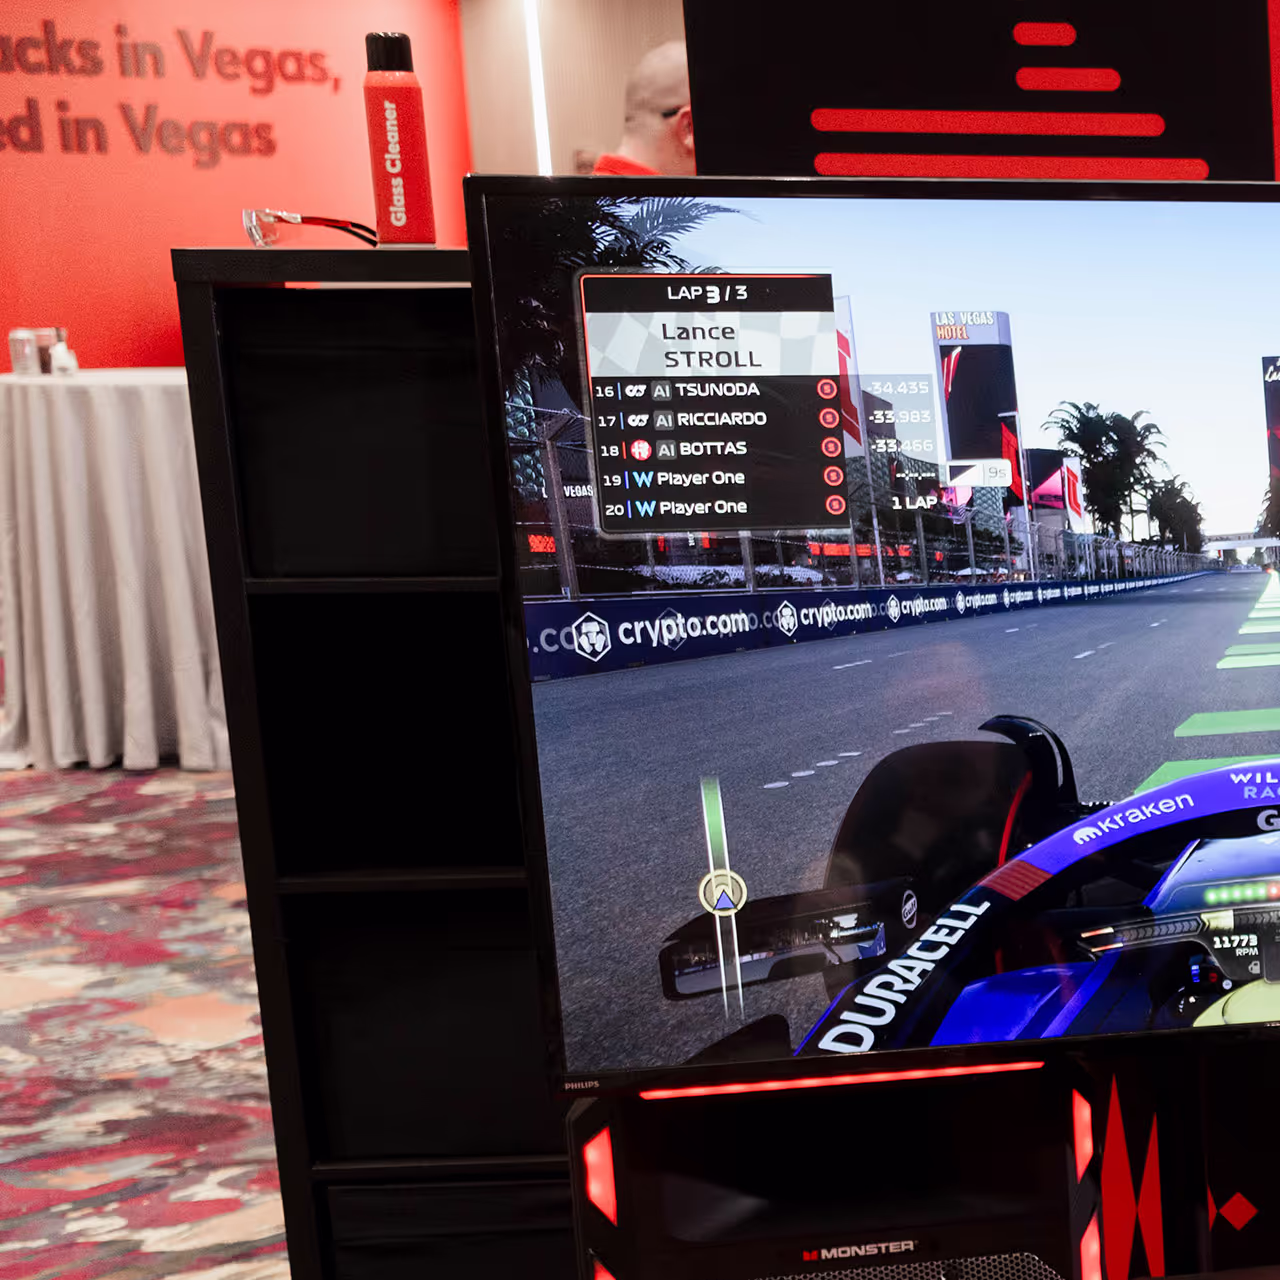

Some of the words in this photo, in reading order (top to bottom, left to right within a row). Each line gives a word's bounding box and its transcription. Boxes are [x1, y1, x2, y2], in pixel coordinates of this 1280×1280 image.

[113, 23, 165, 78] in
[176, 28, 341, 95] Vegas,
[57, 100, 108, 154] in
[120, 102, 277, 170] Vegas
[384, 99, 403, 175] Cleaner
[390, 177, 407, 228] Glass
[667, 286, 702, 300] LAP
[935, 312, 954, 325] LAS
[960, 312, 994, 325] VEGAS
[662, 323, 736, 341] Lance
[936, 325, 970, 339] HOTEL
[665, 350, 763, 369] STROLL
[596, 386, 615, 398] 16
[675, 382, 760, 397] TSUNODA
[866, 381, 929, 396] -34.435
[598, 416, 616, 427] 17
[677, 411, 767, 426] RICCIARDO
[868, 410, 932, 424] -33.983
[600, 445, 619, 457] 18
[680, 441, 748, 456] BOTTAS
[871, 439, 934, 453] -33.466
[603, 475, 621, 487] 19
[657, 472, 710, 488] Player
[716, 471, 746, 485] One
[564, 485, 594, 497] VEGAS
[605, 504, 625, 516] 20
[660, 501, 713, 517] Player
[718, 500, 748, 514] One
[892, 497, 901, 510] 1
[906, 496, 938, 510] LAP
[800, 600, 874, 628] crypto.com
[901, 596, 947, 617] crypto.com
[617, 612, 750, 648] crypto.com
[1098, 793, 1195, 833] kraken
[1213, 934, 1258, 949] 11773
[1236, 948, 1259, 957] RPM
[818, 900, 991, 1053] DURACELL
[565, 1081, 600, 1090] PHILIPS
[821, 1240, 914, 1260] MONSTER
